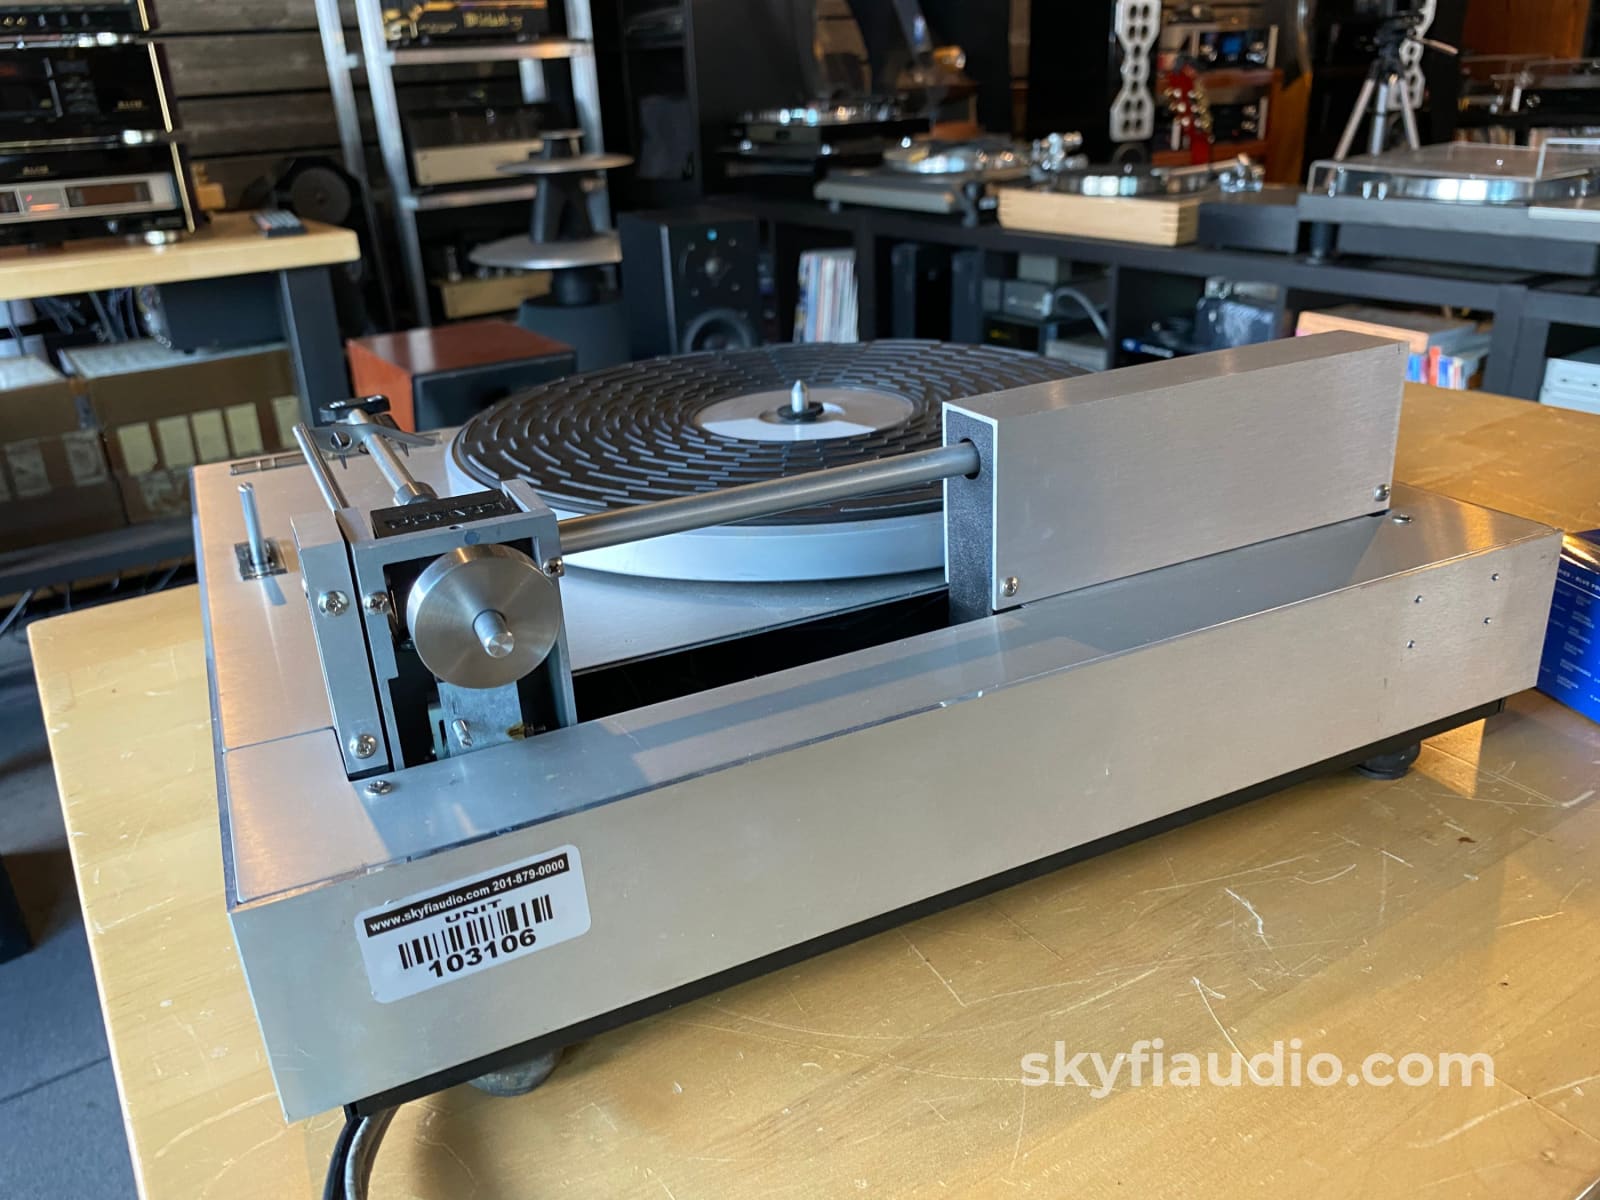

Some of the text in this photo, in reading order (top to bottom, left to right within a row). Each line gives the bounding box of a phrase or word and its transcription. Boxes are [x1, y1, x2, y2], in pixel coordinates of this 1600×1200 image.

[369, 859, 565, 932] www.skyfiaudio.com 201-879-0000
[444, 899, 503, 924] UNIT
[428, 928, 537, 978] 103106
